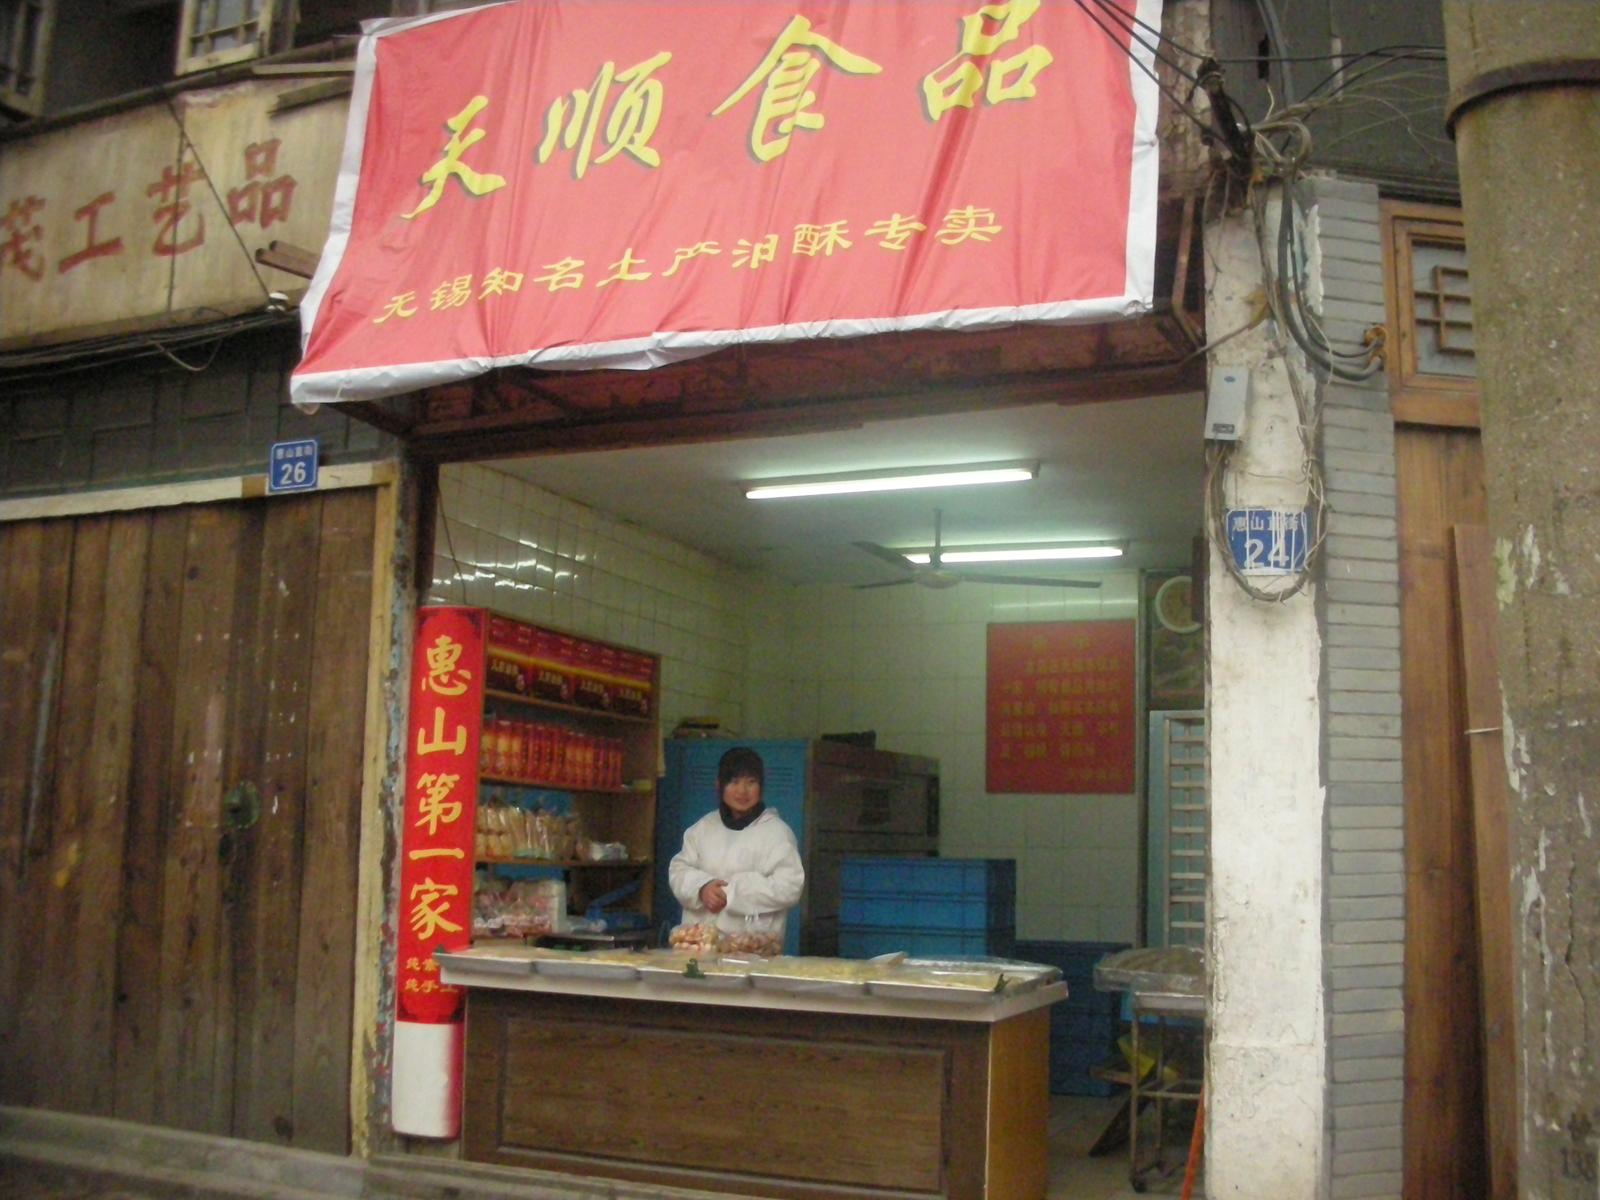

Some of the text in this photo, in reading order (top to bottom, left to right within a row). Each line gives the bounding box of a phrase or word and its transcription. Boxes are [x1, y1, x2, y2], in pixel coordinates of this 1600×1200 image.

[400, 0, 1053, 218] 天顺食品
[281, 461, 306, 485] 26
[1244, 538, 1290, 567] 24
[409, 634, 472, 940] 惠山第一家
